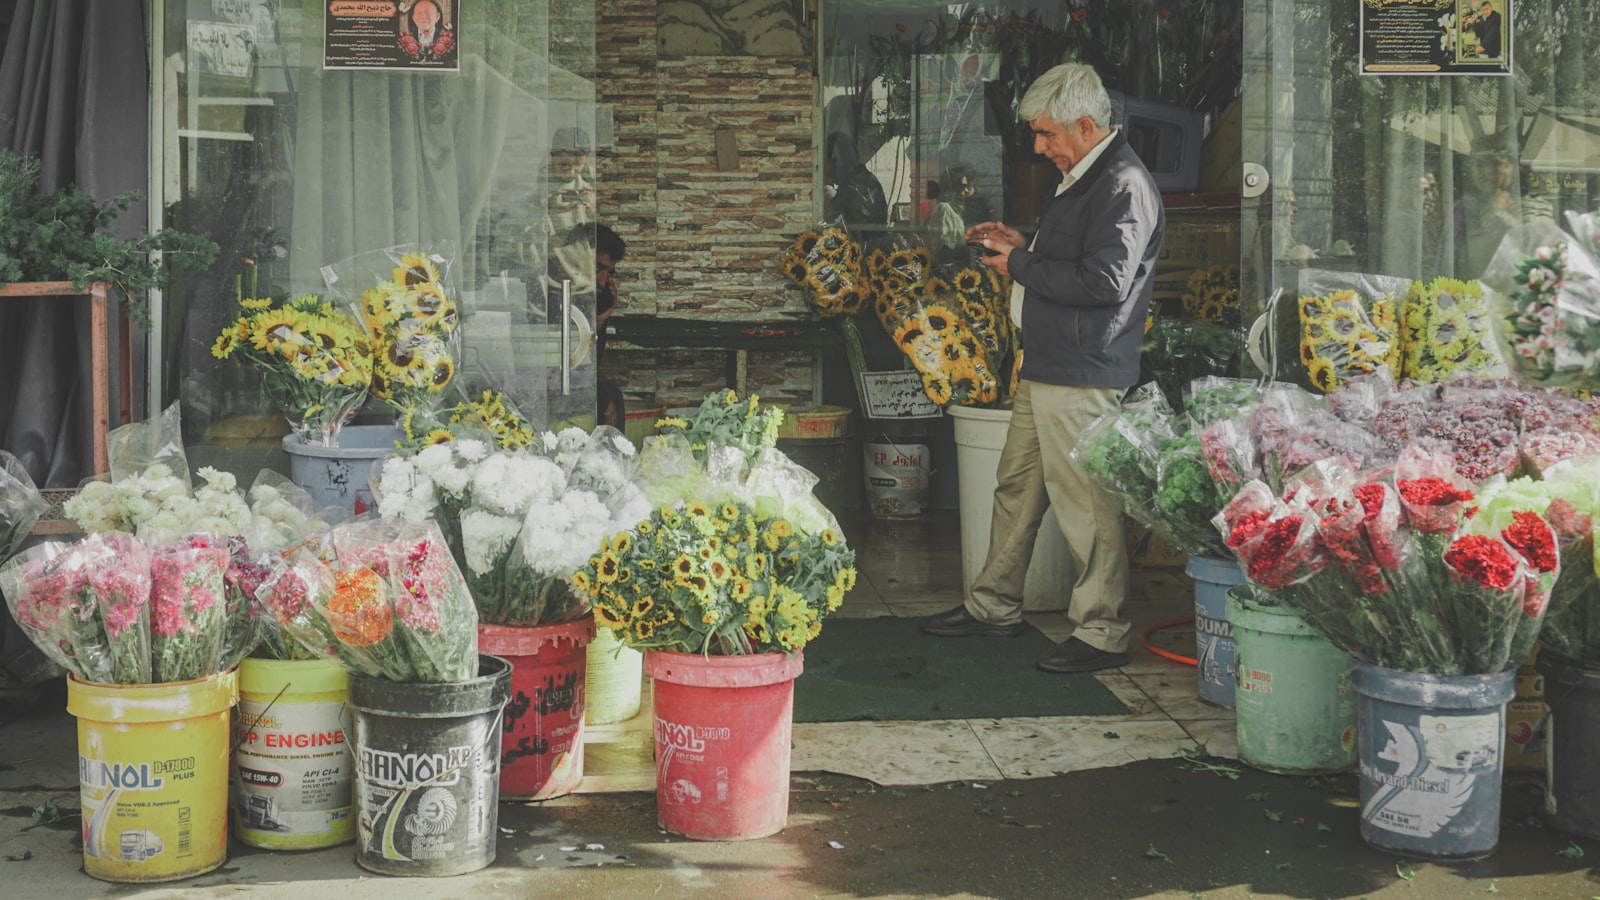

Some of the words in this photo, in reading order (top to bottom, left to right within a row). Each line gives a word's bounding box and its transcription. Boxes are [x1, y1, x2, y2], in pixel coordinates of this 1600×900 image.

[356, 3, 366, 11] الله
[380, 4, 391, 12] حاج
[874, 451, 887, 465] EP
[265, 730, 345, 748] ENGINE
[449, 746, 472, 767] XP
[173, 771, 195, 781] PLUS
[241, 771, 253, 780] SAE
[303, 770, 320, 778] API
[1374, 767, 1408, 788] Arvand
[1411, 775, 1449, 793] Diesel
[152, 799, 180, 808] Approved
